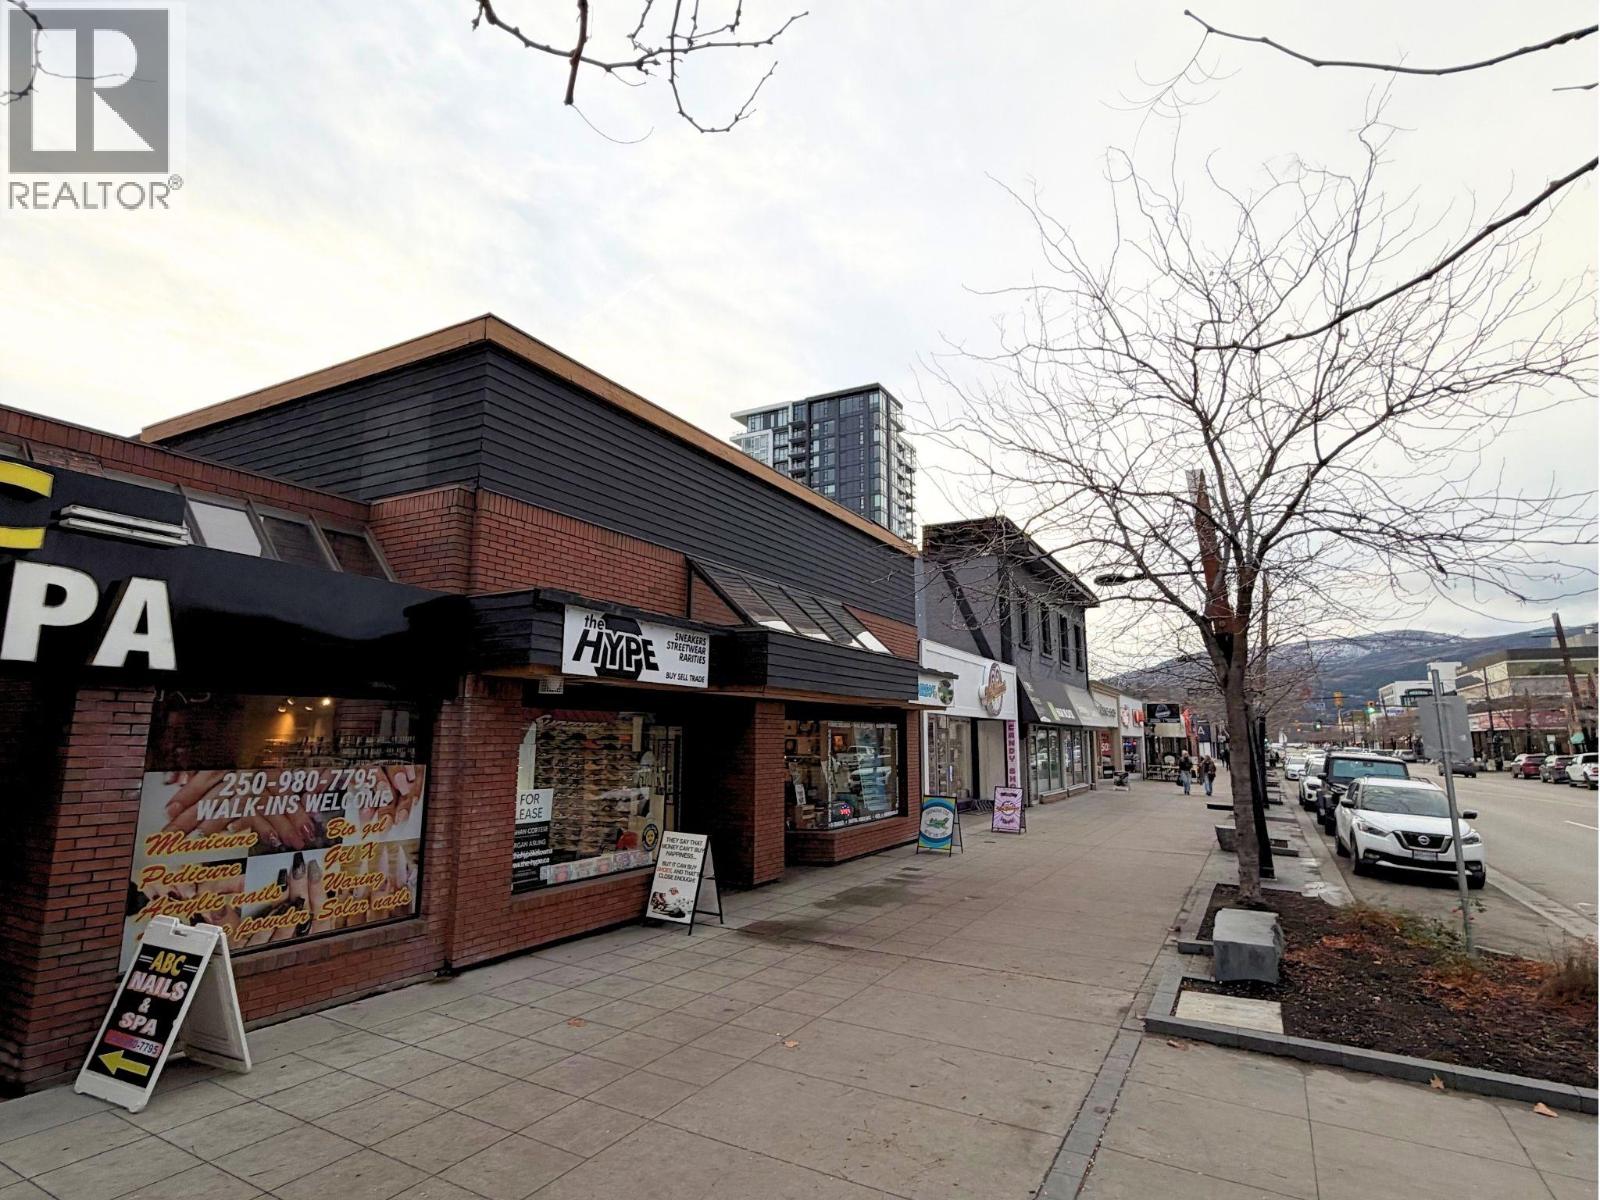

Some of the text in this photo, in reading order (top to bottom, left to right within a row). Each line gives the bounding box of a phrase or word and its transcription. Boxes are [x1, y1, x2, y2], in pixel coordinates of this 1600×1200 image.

[584, 614, 606, 630] the
[572, 629, 660, 672] HYPE
[666, 640, 707, 656] STREETWEAR
[674, 632, 707, 646] SNEAKERS
[678, 652, 706, 665] RARITIES
[665, 672, 705, 684] BUY SELL TRADE
[218, 768, 378, 797] 250-980-7795
[196, 788, 394, 822] WALK-INS WELCOME
[520, 793, 540, 806] FOR
[516, 807, 544, 820] EASE
[325, 815, 389, 840] Bio gel
[144, 831, 259, 857] Manicure
[323, 841, 379, 869] Gel X
[139, 862, 242, 890] Pedicure
[322, 871, 386, 894] Waxing
[136, 883, 285, 924] Acrylic nails
[317, 887, 413, 921] Solar nails
[234, 906, 310, 942] powder
[150, 950, 187, 977] ABC
[126, 970, 189, 1002] NAILS
[137, 997, 152, 1014] &
[118, 1011, 158, 1037] SPA
